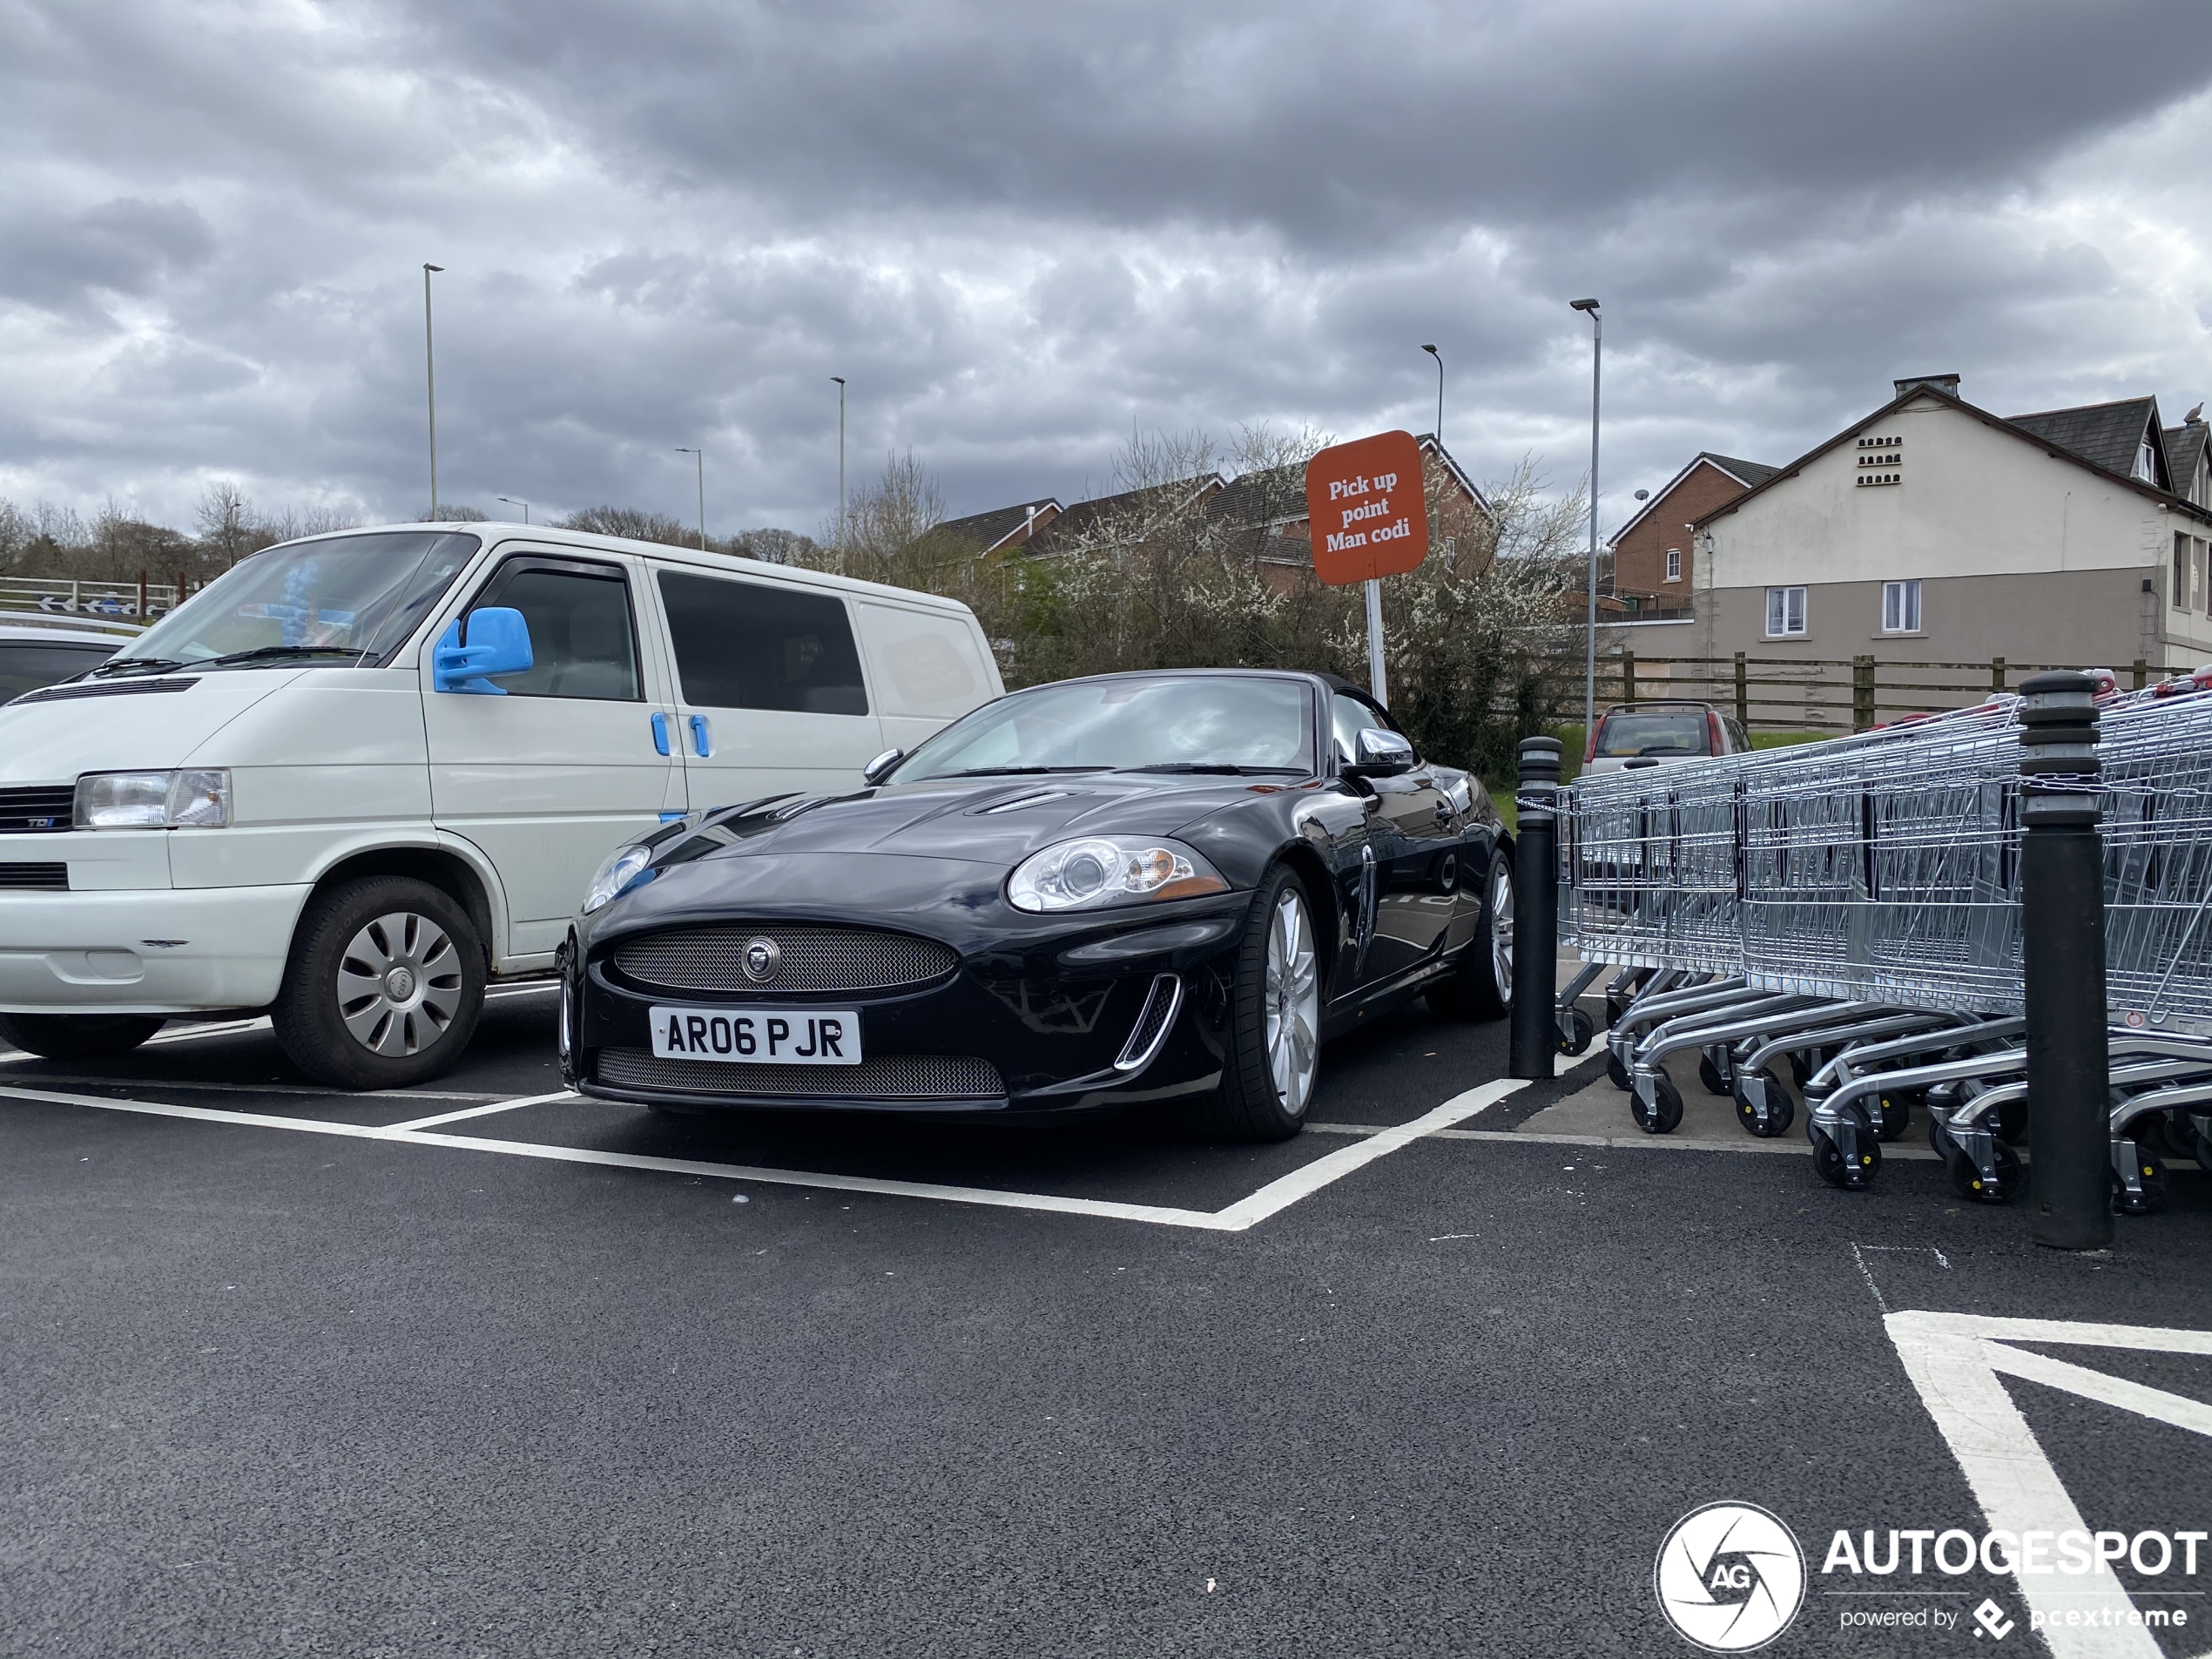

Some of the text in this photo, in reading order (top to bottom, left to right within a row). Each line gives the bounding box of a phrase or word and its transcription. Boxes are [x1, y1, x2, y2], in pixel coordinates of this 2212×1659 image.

[1329, 472, 1398, 501] Pick up
[1341, 498, 1389, 529] point
[1325, 517, 1411, 552] Man codi
[668, 1015, 844, 1057] AR06 PJR
